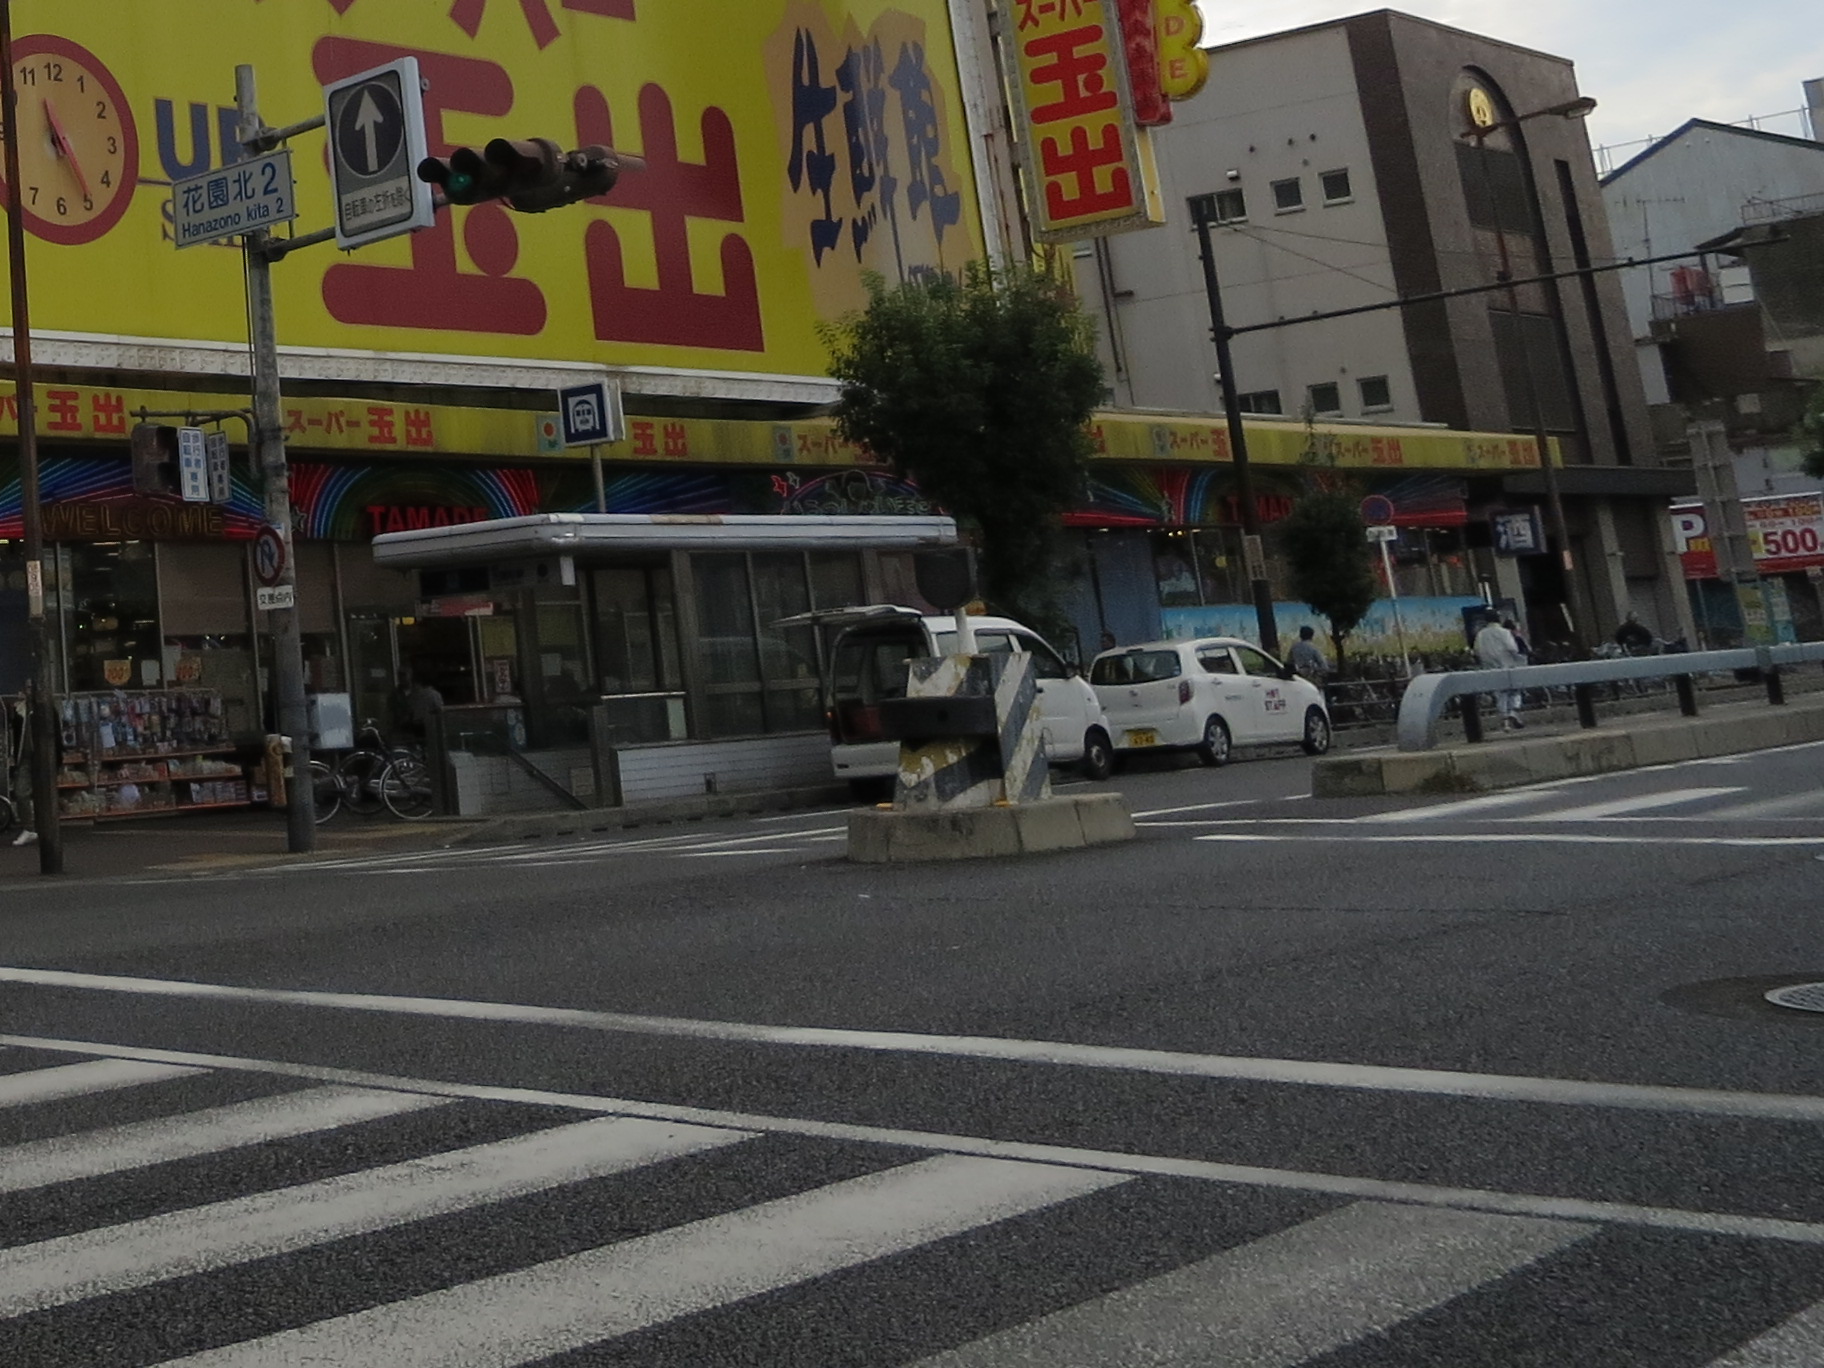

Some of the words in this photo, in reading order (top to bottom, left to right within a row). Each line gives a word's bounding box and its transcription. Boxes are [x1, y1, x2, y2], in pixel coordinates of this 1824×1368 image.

[20, 66, 35, 86] 11
[44, 62, 63, 82] 12
[77, 75, 85, 93] 1
[96, 101, 107, 120] 2
[1024, 24, 1133, 222] 玉出
[107, 136, 117, 154] 3
[101, 170, 111, 188] 4
[29, 187, 39, 206] 7
[56, 197, 67, 216] 6
[83, 193, 94, 211] 5
[182, 212, 241, 239] Hanazono
[246, 203, 270, 222] kita
[276, 197, 284, 213] 2
[631, 421, 687, 457] 玉出
[40, 502, 225, 537] WELCOME
[1495, 513, 1536, 551] 酒
[1670, 513, 1706, 555] P
[1763, 528, 1819, 555] 500
